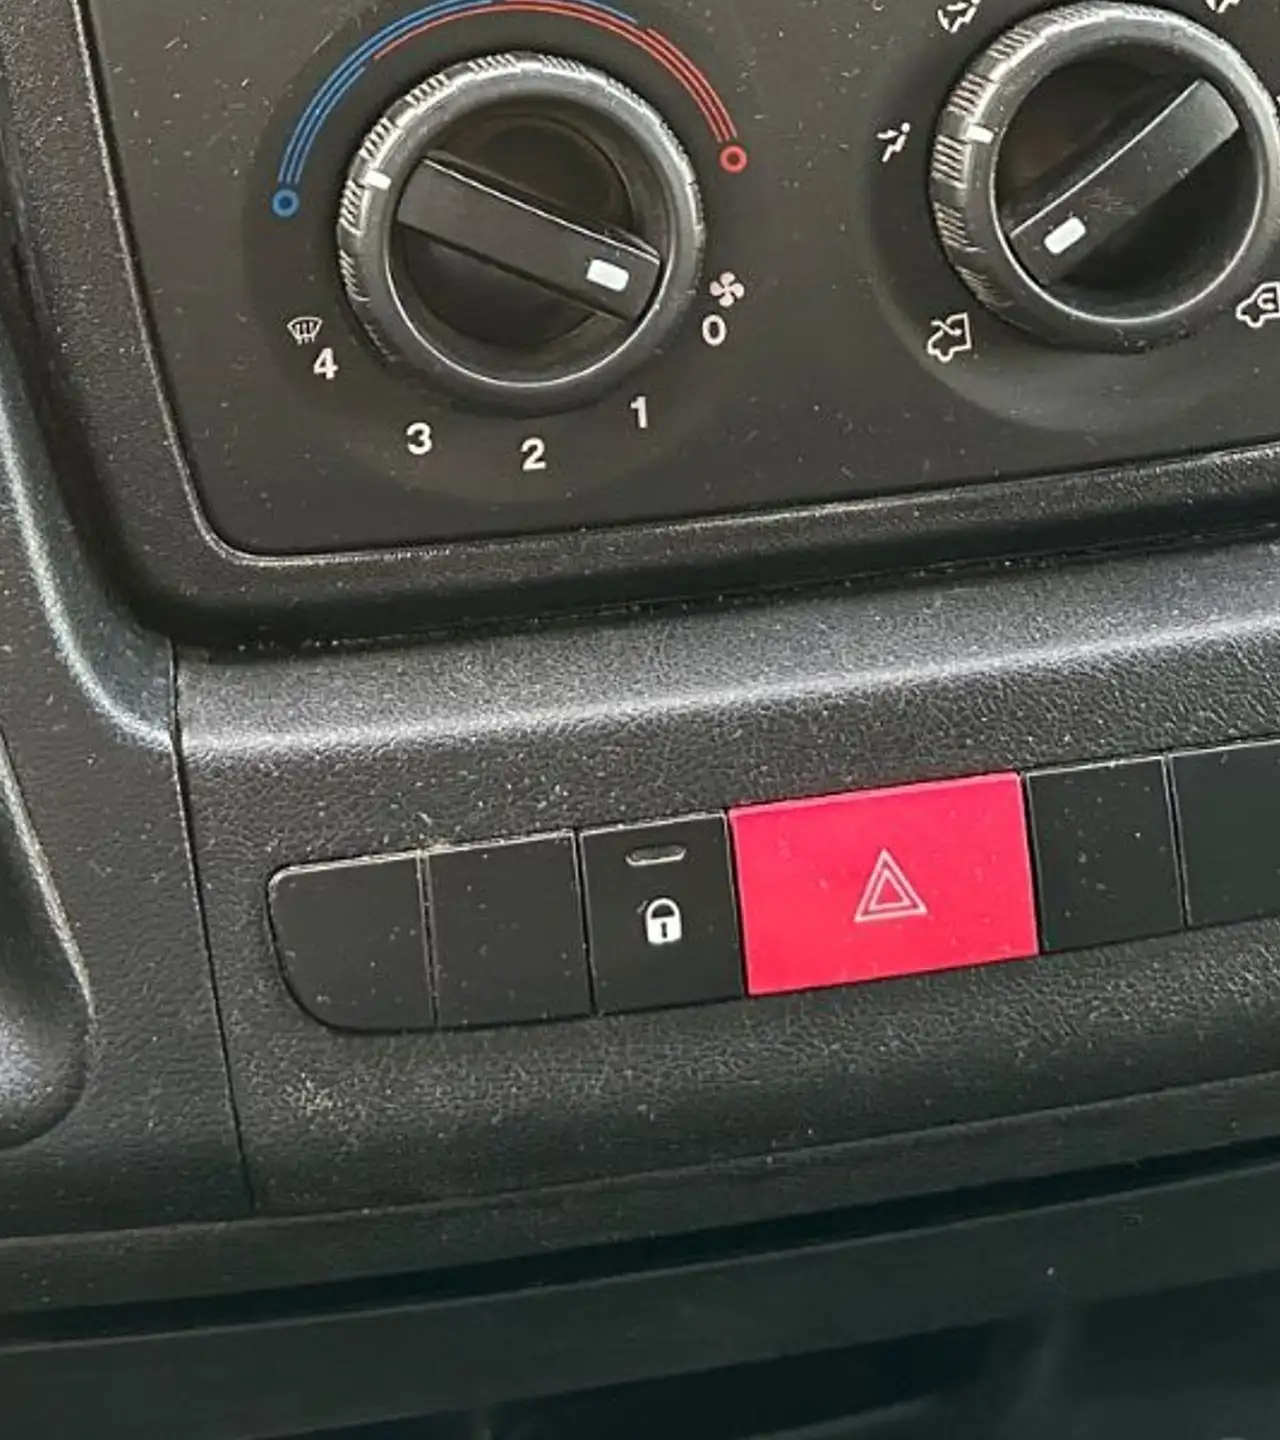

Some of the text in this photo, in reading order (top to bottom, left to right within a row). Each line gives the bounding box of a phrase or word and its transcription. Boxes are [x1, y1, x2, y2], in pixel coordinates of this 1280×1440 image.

[701, 314, 727, 347] 0
[313, 347, 339, 381] 4
[630, 396, 649, 430] 1
[406, 422, 433, 456] 3
[520, 437, 547, 471] 2
